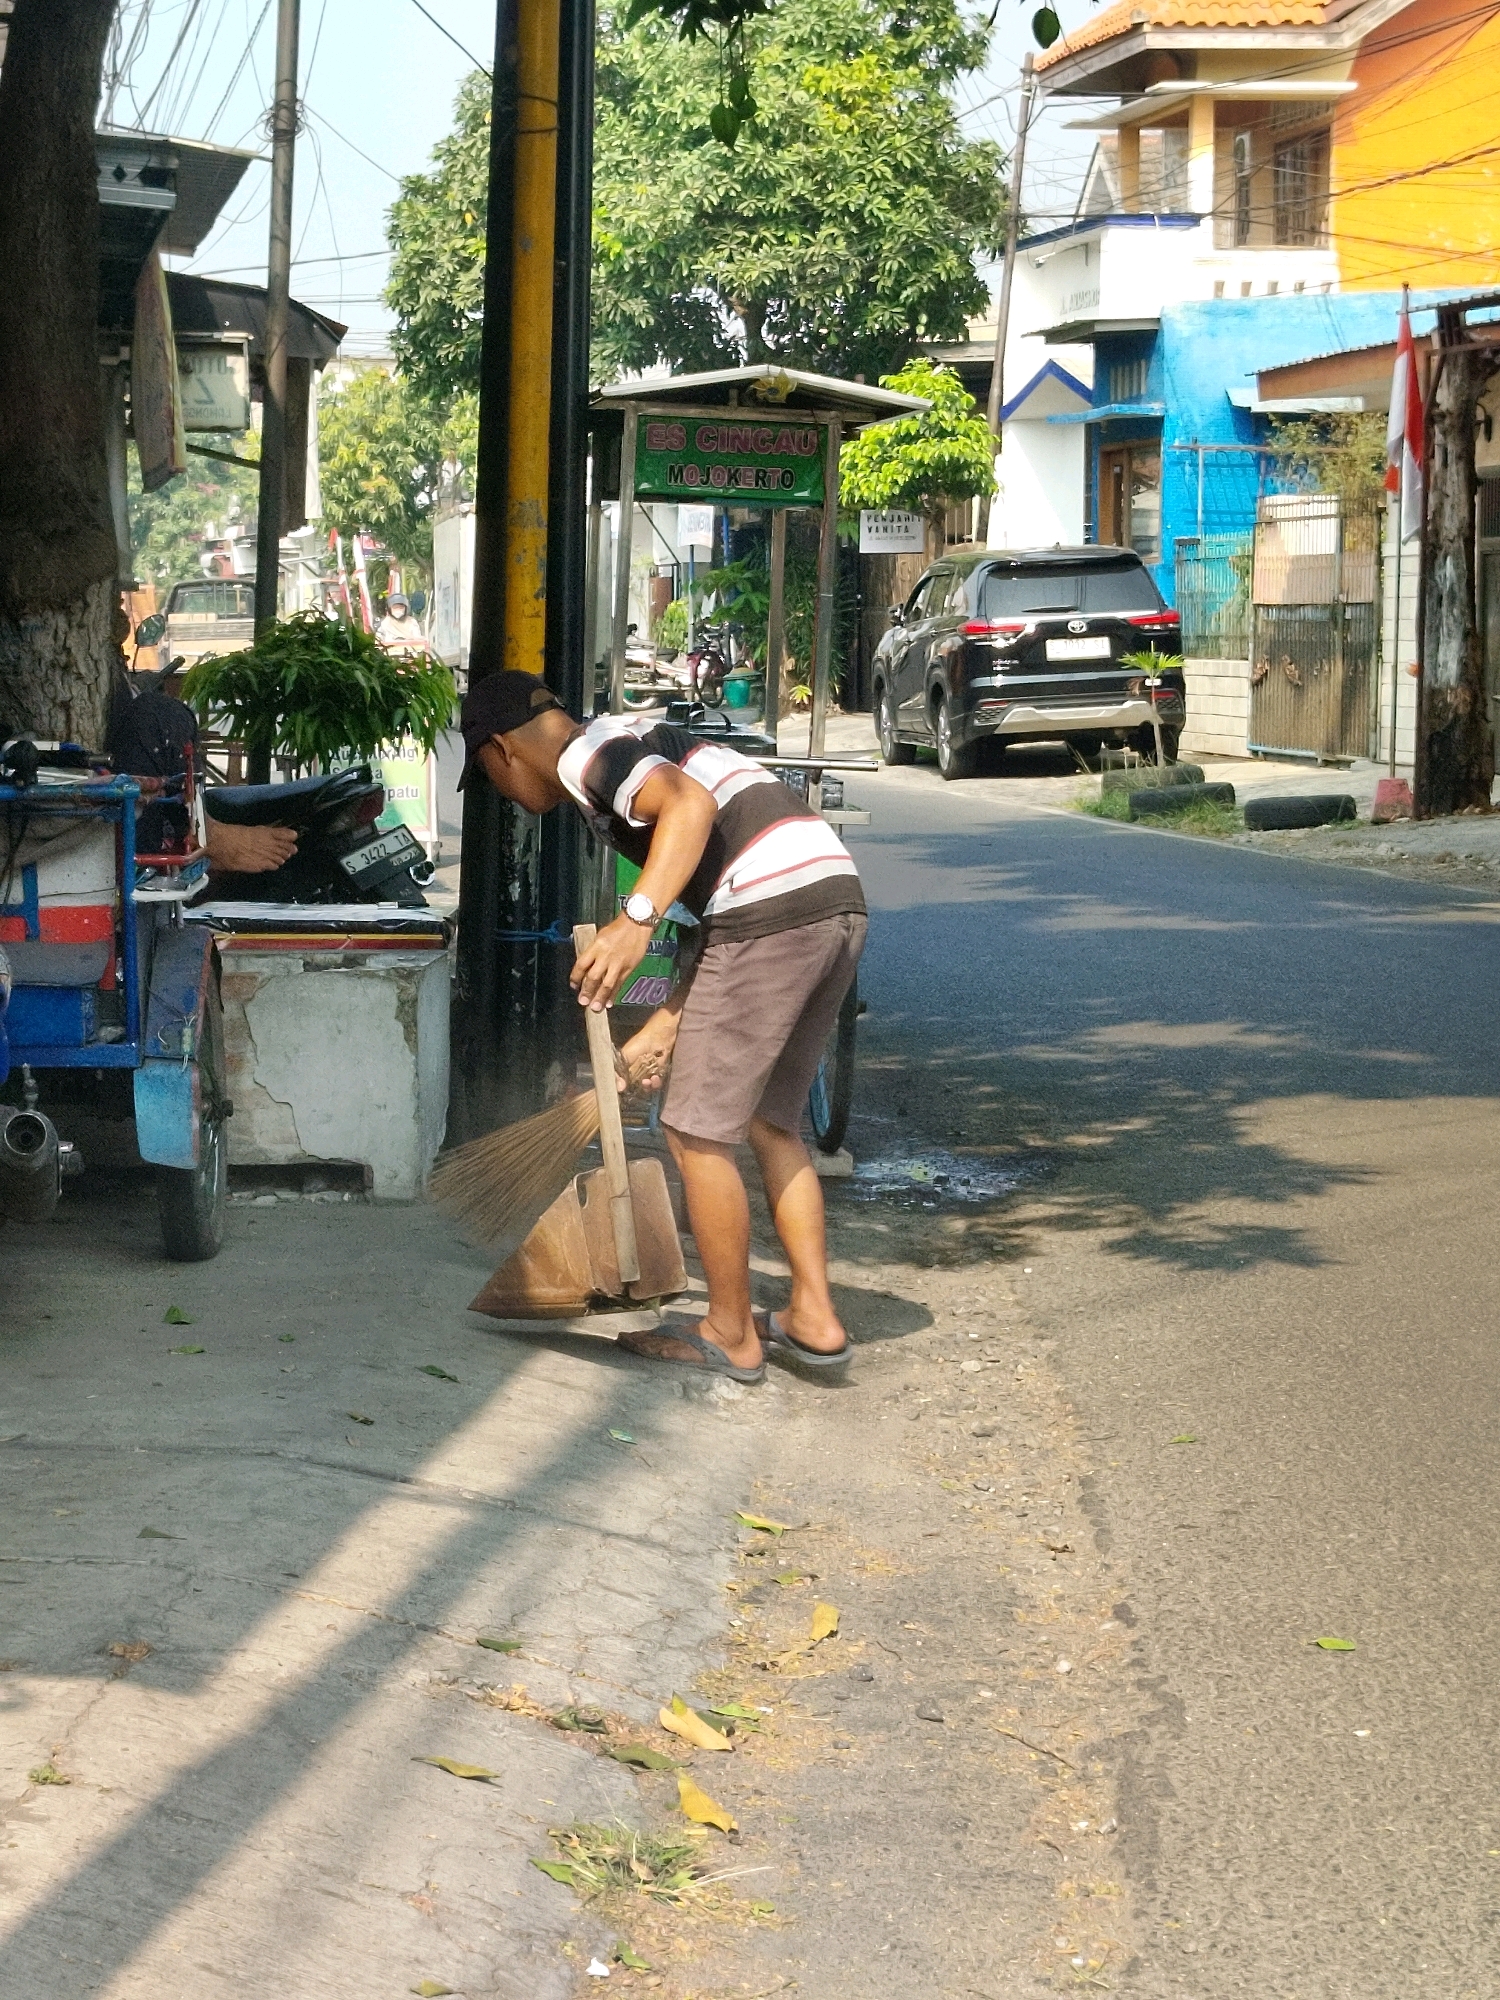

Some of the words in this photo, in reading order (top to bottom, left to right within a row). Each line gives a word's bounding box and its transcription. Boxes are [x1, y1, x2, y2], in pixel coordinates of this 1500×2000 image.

[646, 423, 687, 451] ES
[695, 425, 818, 457] CINCAU
[667, 463, 796, 491] MOJOKERTO
[345, 860, 357, 873] S
[360, 843, 388, 865] 3422
[393, 832, 411, 847] TA
